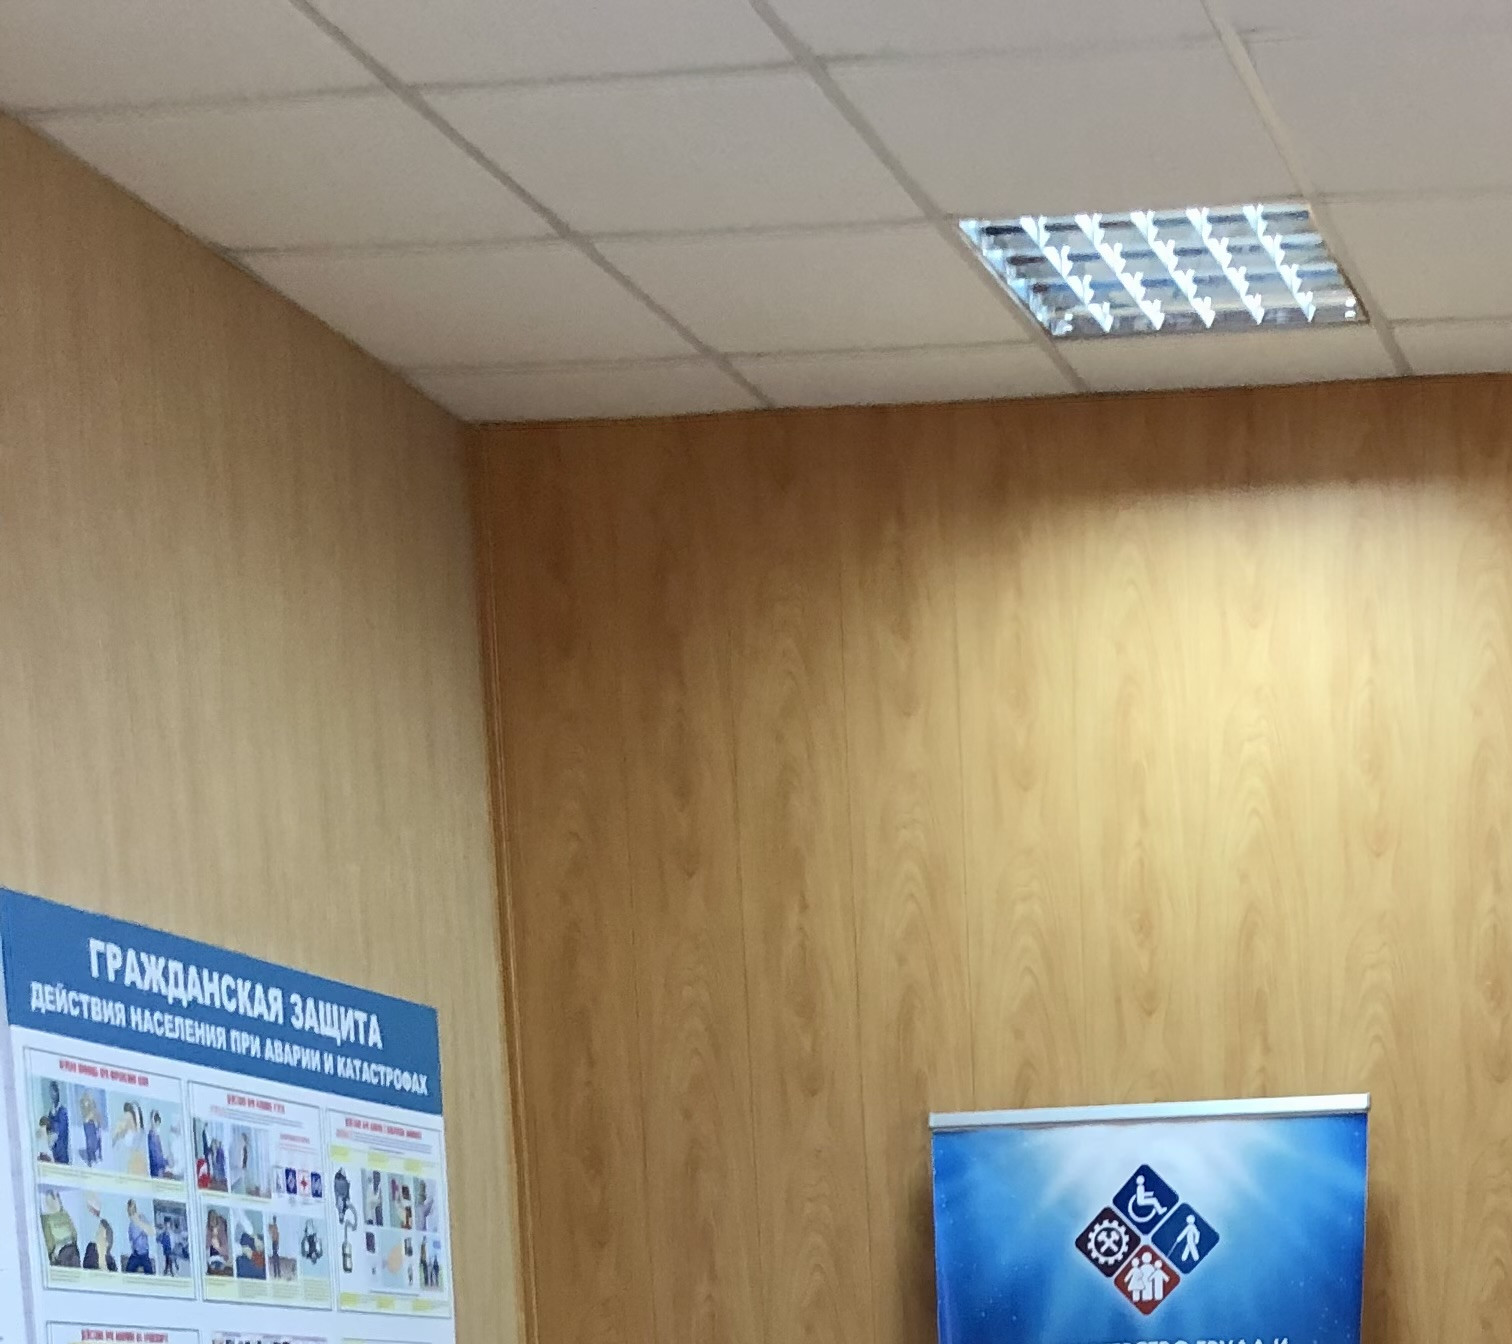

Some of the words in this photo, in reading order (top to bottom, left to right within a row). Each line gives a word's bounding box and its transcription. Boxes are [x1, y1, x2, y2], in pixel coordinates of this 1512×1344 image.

[30, 981, 127, 1028] ДЕЙСТВИЯ
[129, 1005, 227, 1051] НАСЕЛЕНИЯ
[230, 1028, 262, 1059] ПРИ
[264, 1038, 321, 1073] АВАРИИ
[323, 1052, 335, 1076] И
[336, 1055, 428, 1096] КАТАСТРОФАХ
[88, 937, 284, 1025] ГРАЖДАНСКАЯ
[290, 993, 383, 1050] ЗАЩИТА
